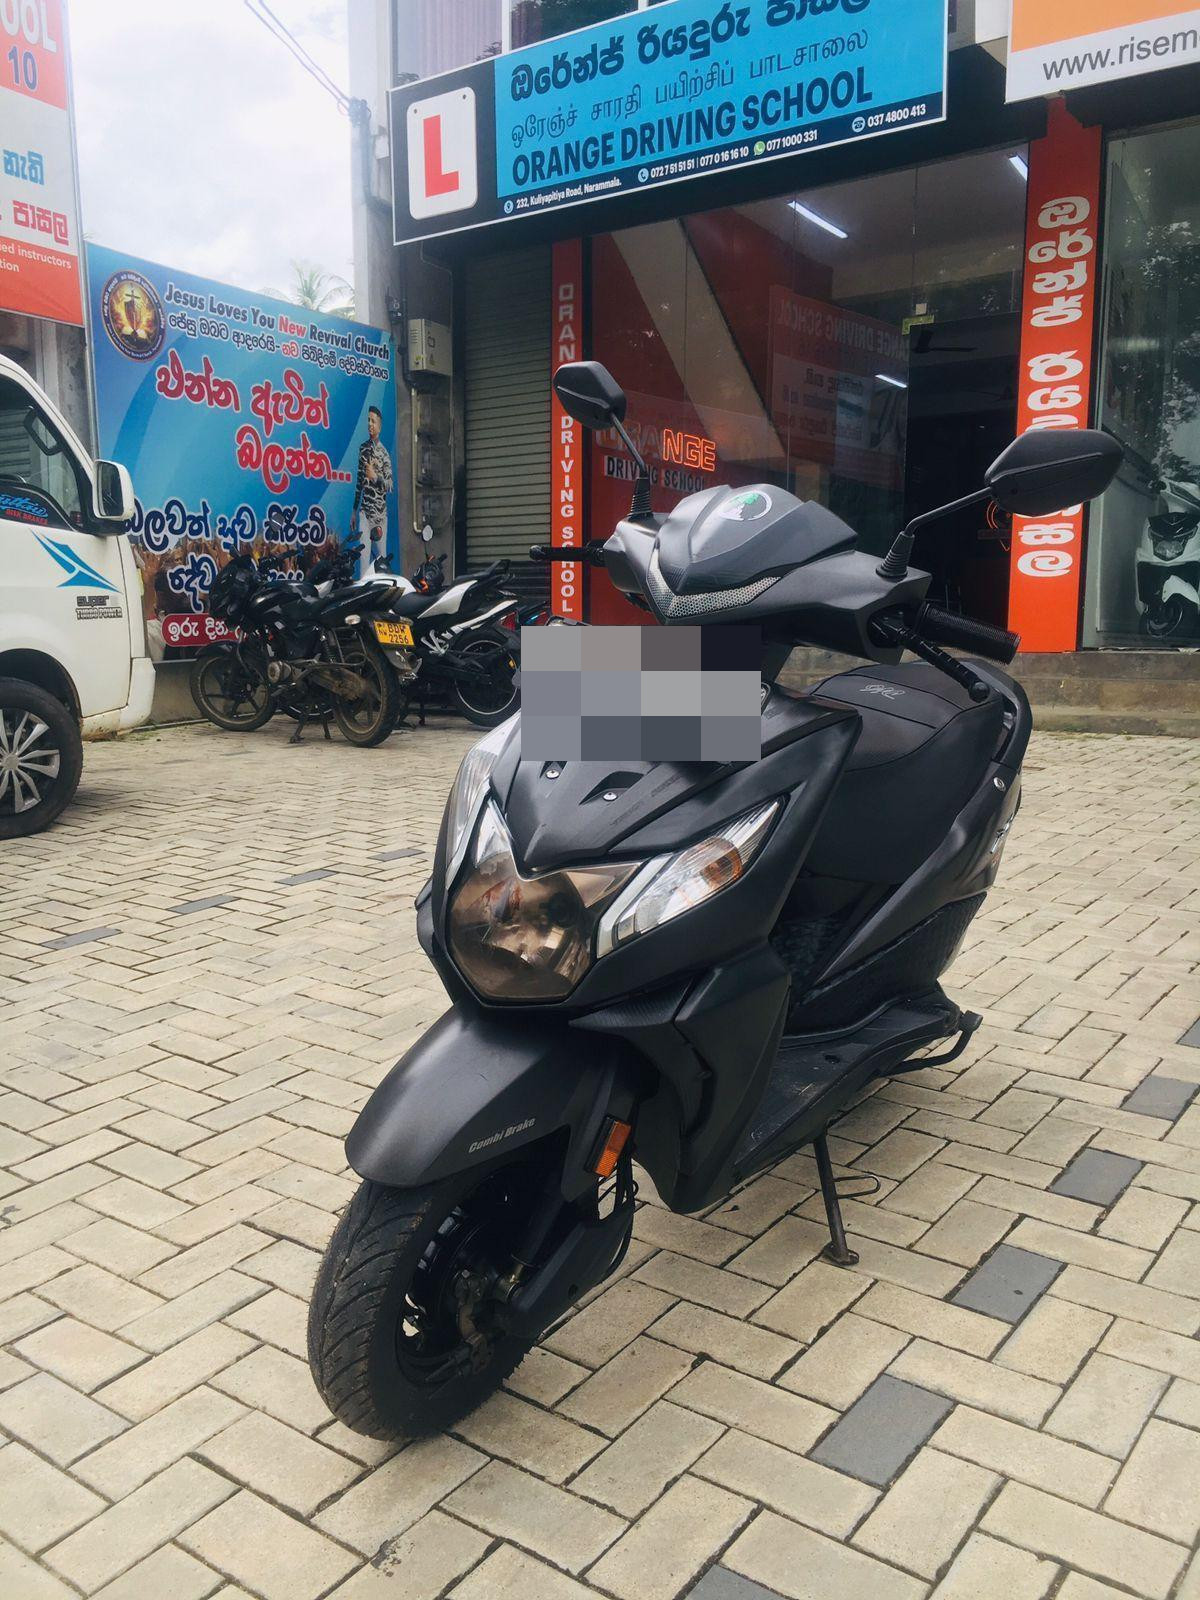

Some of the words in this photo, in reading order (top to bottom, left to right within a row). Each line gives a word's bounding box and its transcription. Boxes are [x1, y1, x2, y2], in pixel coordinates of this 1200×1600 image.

[8, 45, 38, 91] 10
[590, 83, 642, 122] சாரதி
[750, 29, 869, 79] பாடசாலை
[1042, 28, 1200, 81] www.risem
[512, 131, 615, 186] ORANGE
[621, 100, 737, 162] DRIVING
[741, 66, 872, 130] SCHOOL
[803, 129, 818, 144] 331
[867, 114, 884, 128] 037
[885, 107, 909, 123] 4800
[910, 103, 926, 118] 413
[422, 115, 460, 198] L
[12, 199, 69, 247] පාසල
[0, 242, 15, 255] ed
[17, 245, 72, 269] instructors
[164, 281, 206, 311] Jesus
[208, 295, 248, 323] Loves
[250, 307, 275, 330] You
[278, 314, 307, 338] New
[309, 323, 352, 350] Revival
[355, 335, 389, 361] Church
[558, 284, 576, 362] ORAN
[560, 415, 575, 518] DRIVING
[604, 455, 659, 485] DRIVNG
[388, 634, 410, 644] 2256
[468, 1131, 505, 1154] Combi
[504, 1117, 536, 1139] Brake
